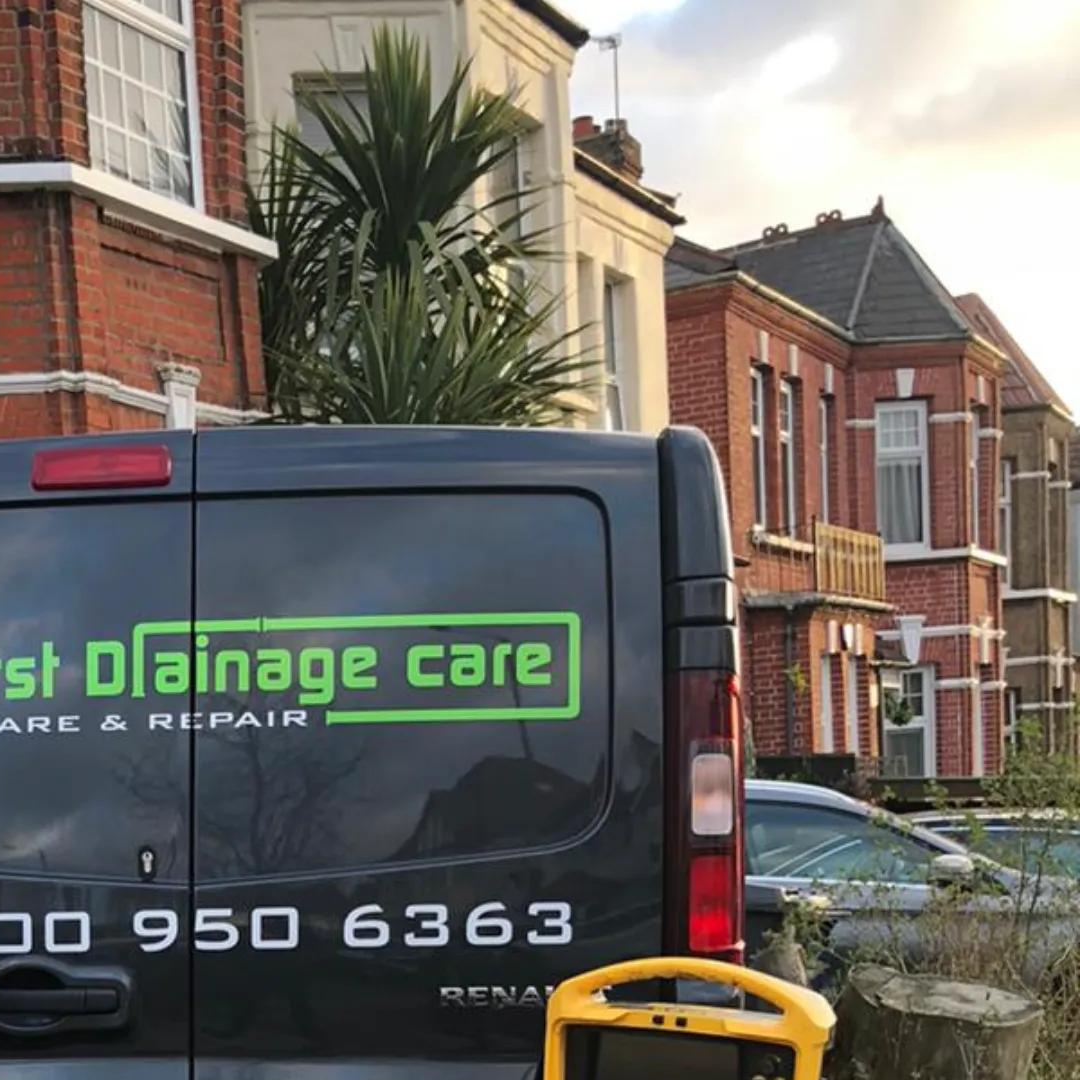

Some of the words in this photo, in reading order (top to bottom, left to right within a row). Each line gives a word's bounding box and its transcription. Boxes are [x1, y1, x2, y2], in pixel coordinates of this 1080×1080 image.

[407, 642, 552, 688] care
[100, 714, 128, 732] &
[149, 710, 309, 731] REPAIR
[133, 906, 299, 951] 950
[343, 901, 573, 947] 6363
